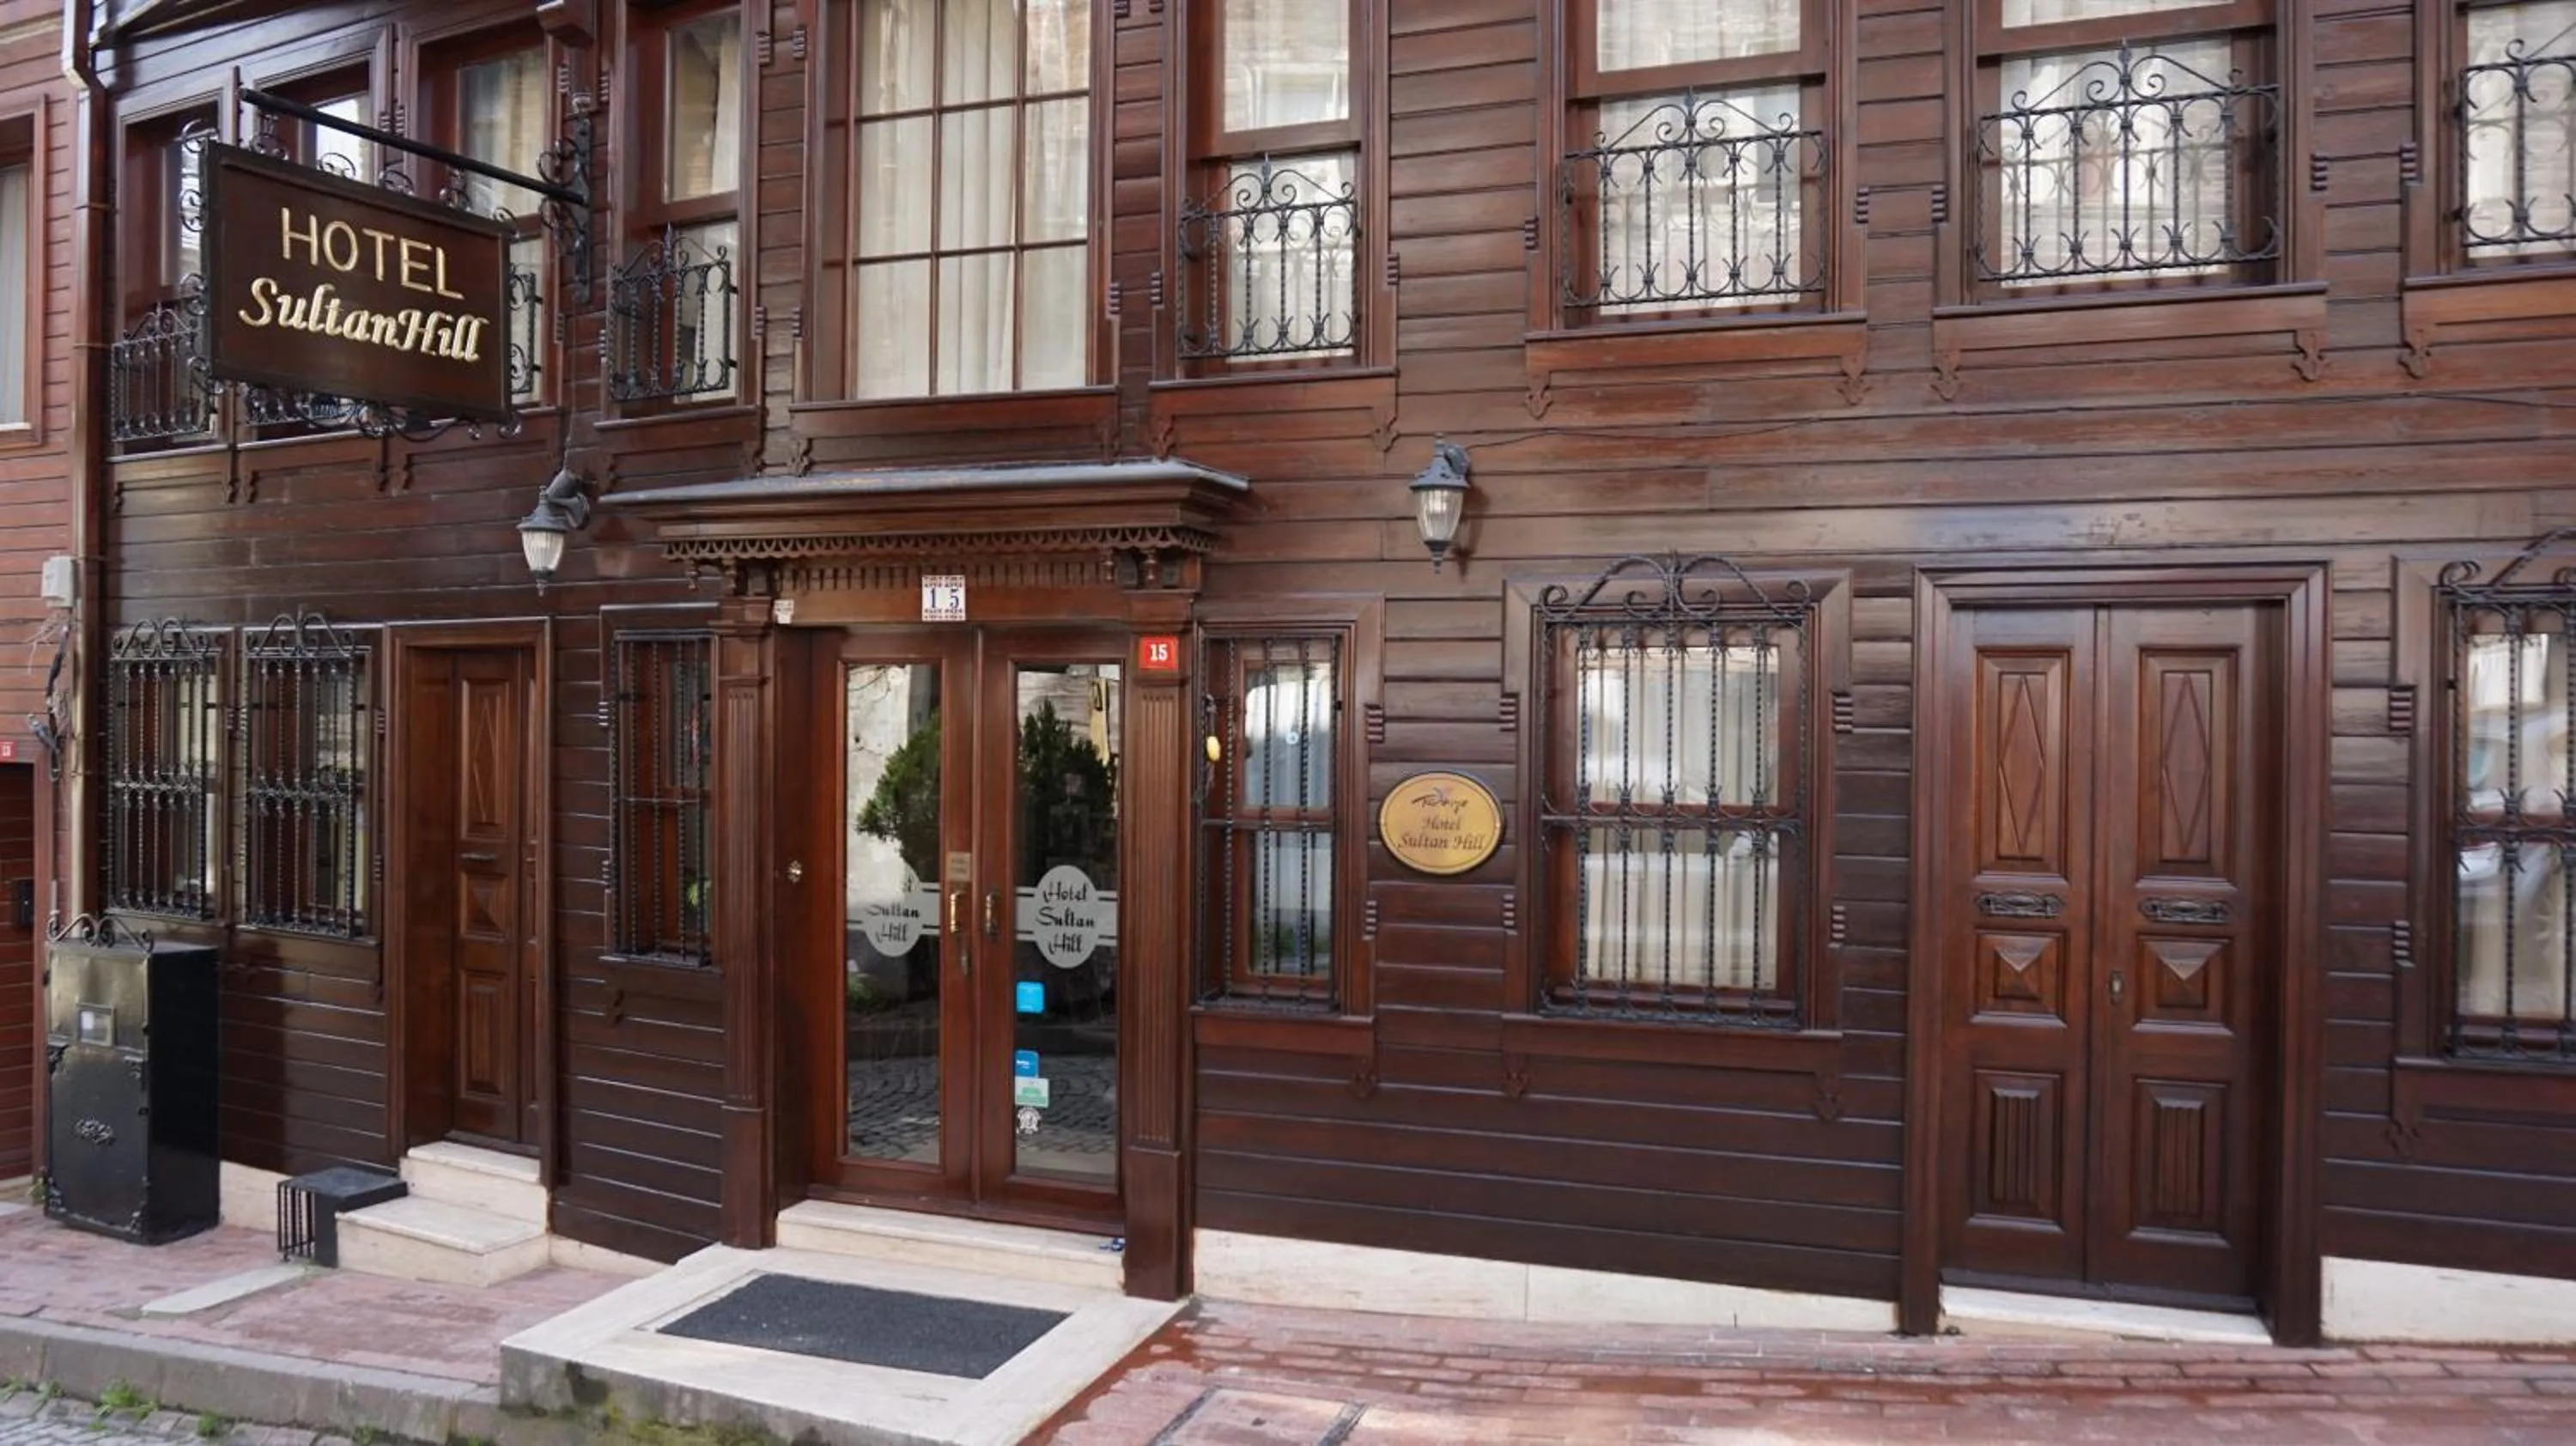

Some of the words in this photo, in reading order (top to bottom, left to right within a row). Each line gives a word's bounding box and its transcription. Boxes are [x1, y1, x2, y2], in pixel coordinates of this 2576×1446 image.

[281, 207, 465, 300] HOTEL
[1150, 643, 1169, 661] 15
[1421, 815, 1461, 830] Hotel
[1398, 831, 1448, 848] Sultan
[1450, 833, 1485, 849] Hill
[1042, 881, 1087, 903] Hotel
[1036, 906, 1095, 927] Sultan
[875, 922, 908, 943] Hill
[1048, 933, 1083, 955] Hill
